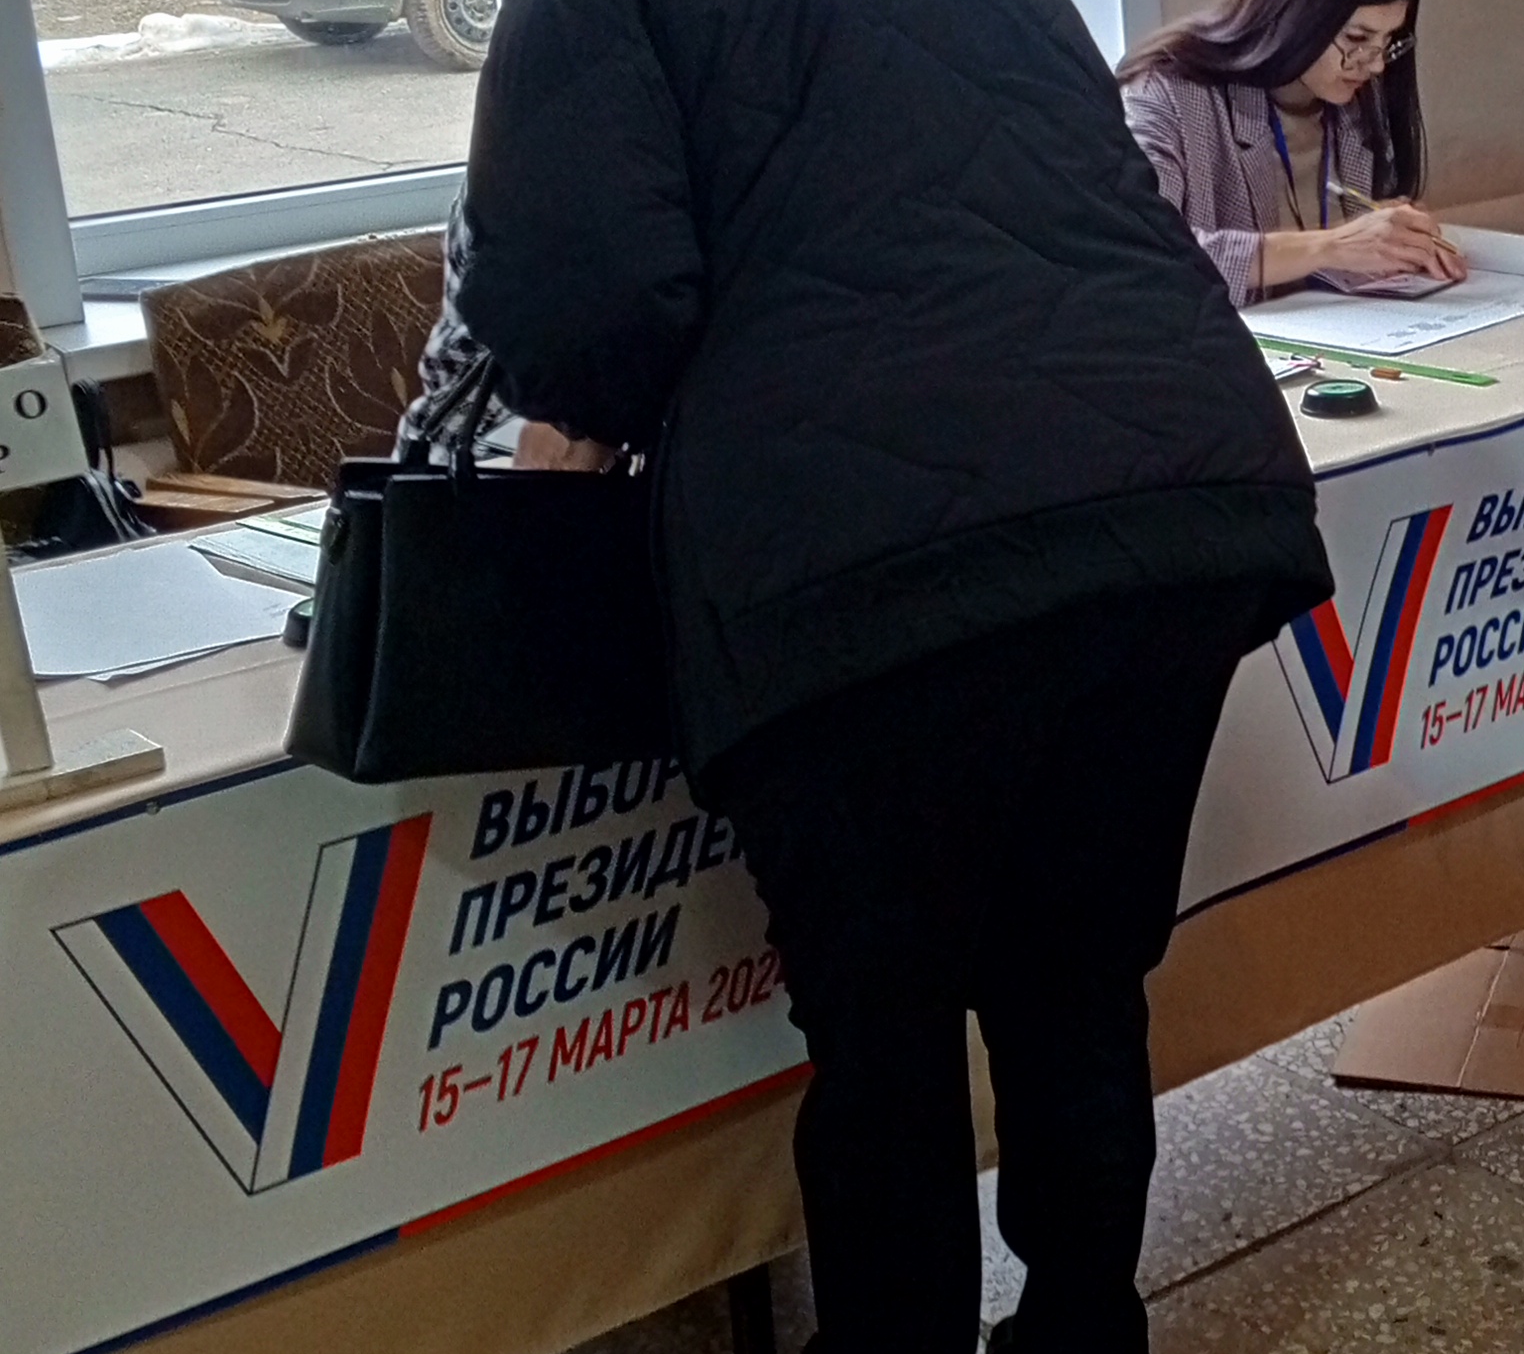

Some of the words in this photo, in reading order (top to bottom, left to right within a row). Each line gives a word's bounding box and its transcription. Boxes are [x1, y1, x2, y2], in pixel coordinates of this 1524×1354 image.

[470, 757, 682, 860] ВЫБОР
[449, 812, 746, 956] ПРЕЗИДЕ
[427, 902, 682, 1052] РОССИИ
[547, 980, 691, 1084] МАРТА
[700, 949, 785, 1025] 202
